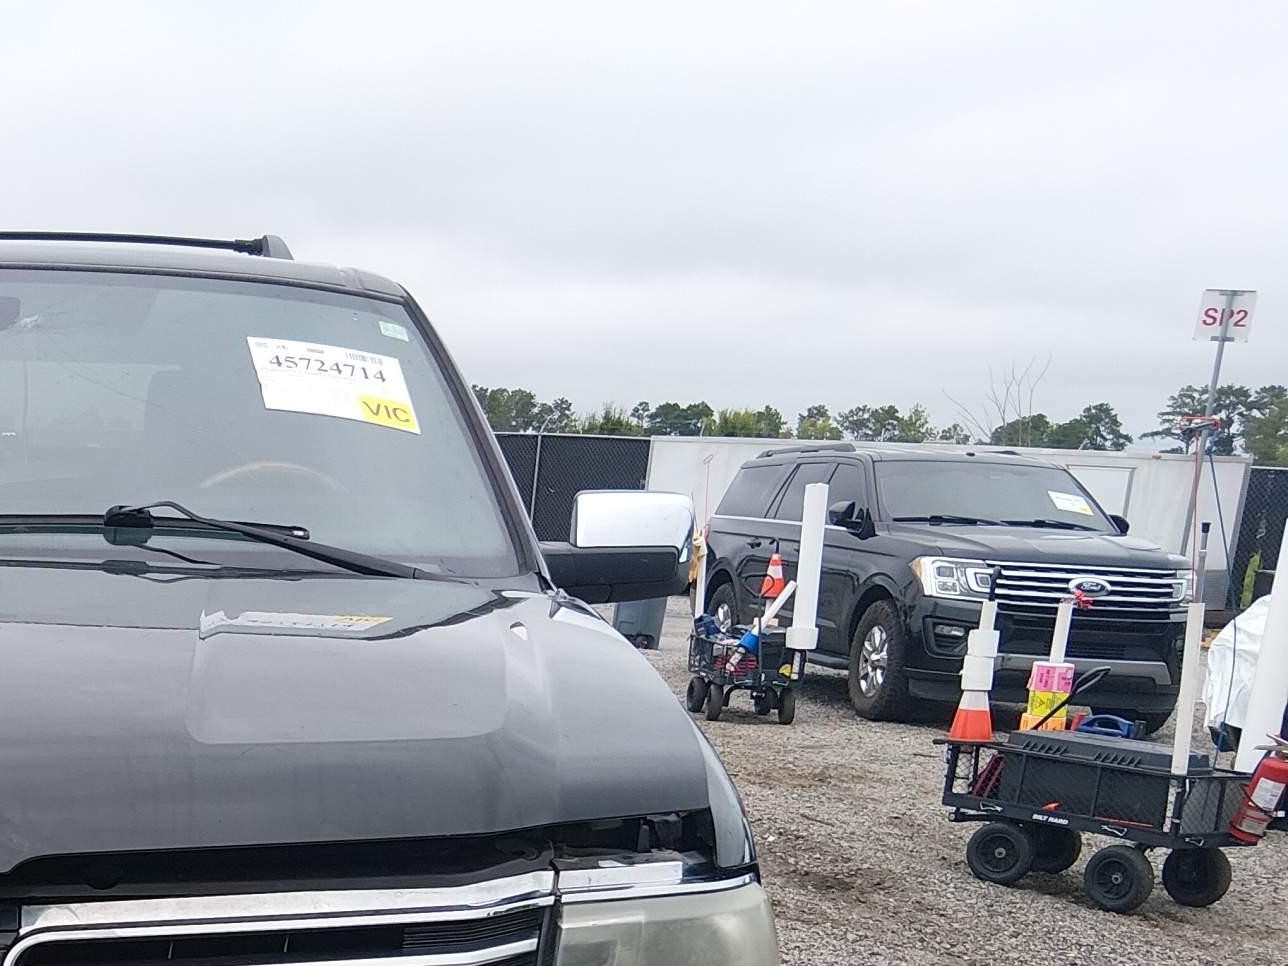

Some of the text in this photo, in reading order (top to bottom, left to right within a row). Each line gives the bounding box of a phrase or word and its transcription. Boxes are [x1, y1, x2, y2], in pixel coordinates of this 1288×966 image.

[1202, 307, 1248, 328] SP2
[268, 354, 387, 383] 45724714
[362, 400, 411, 423] VIC
